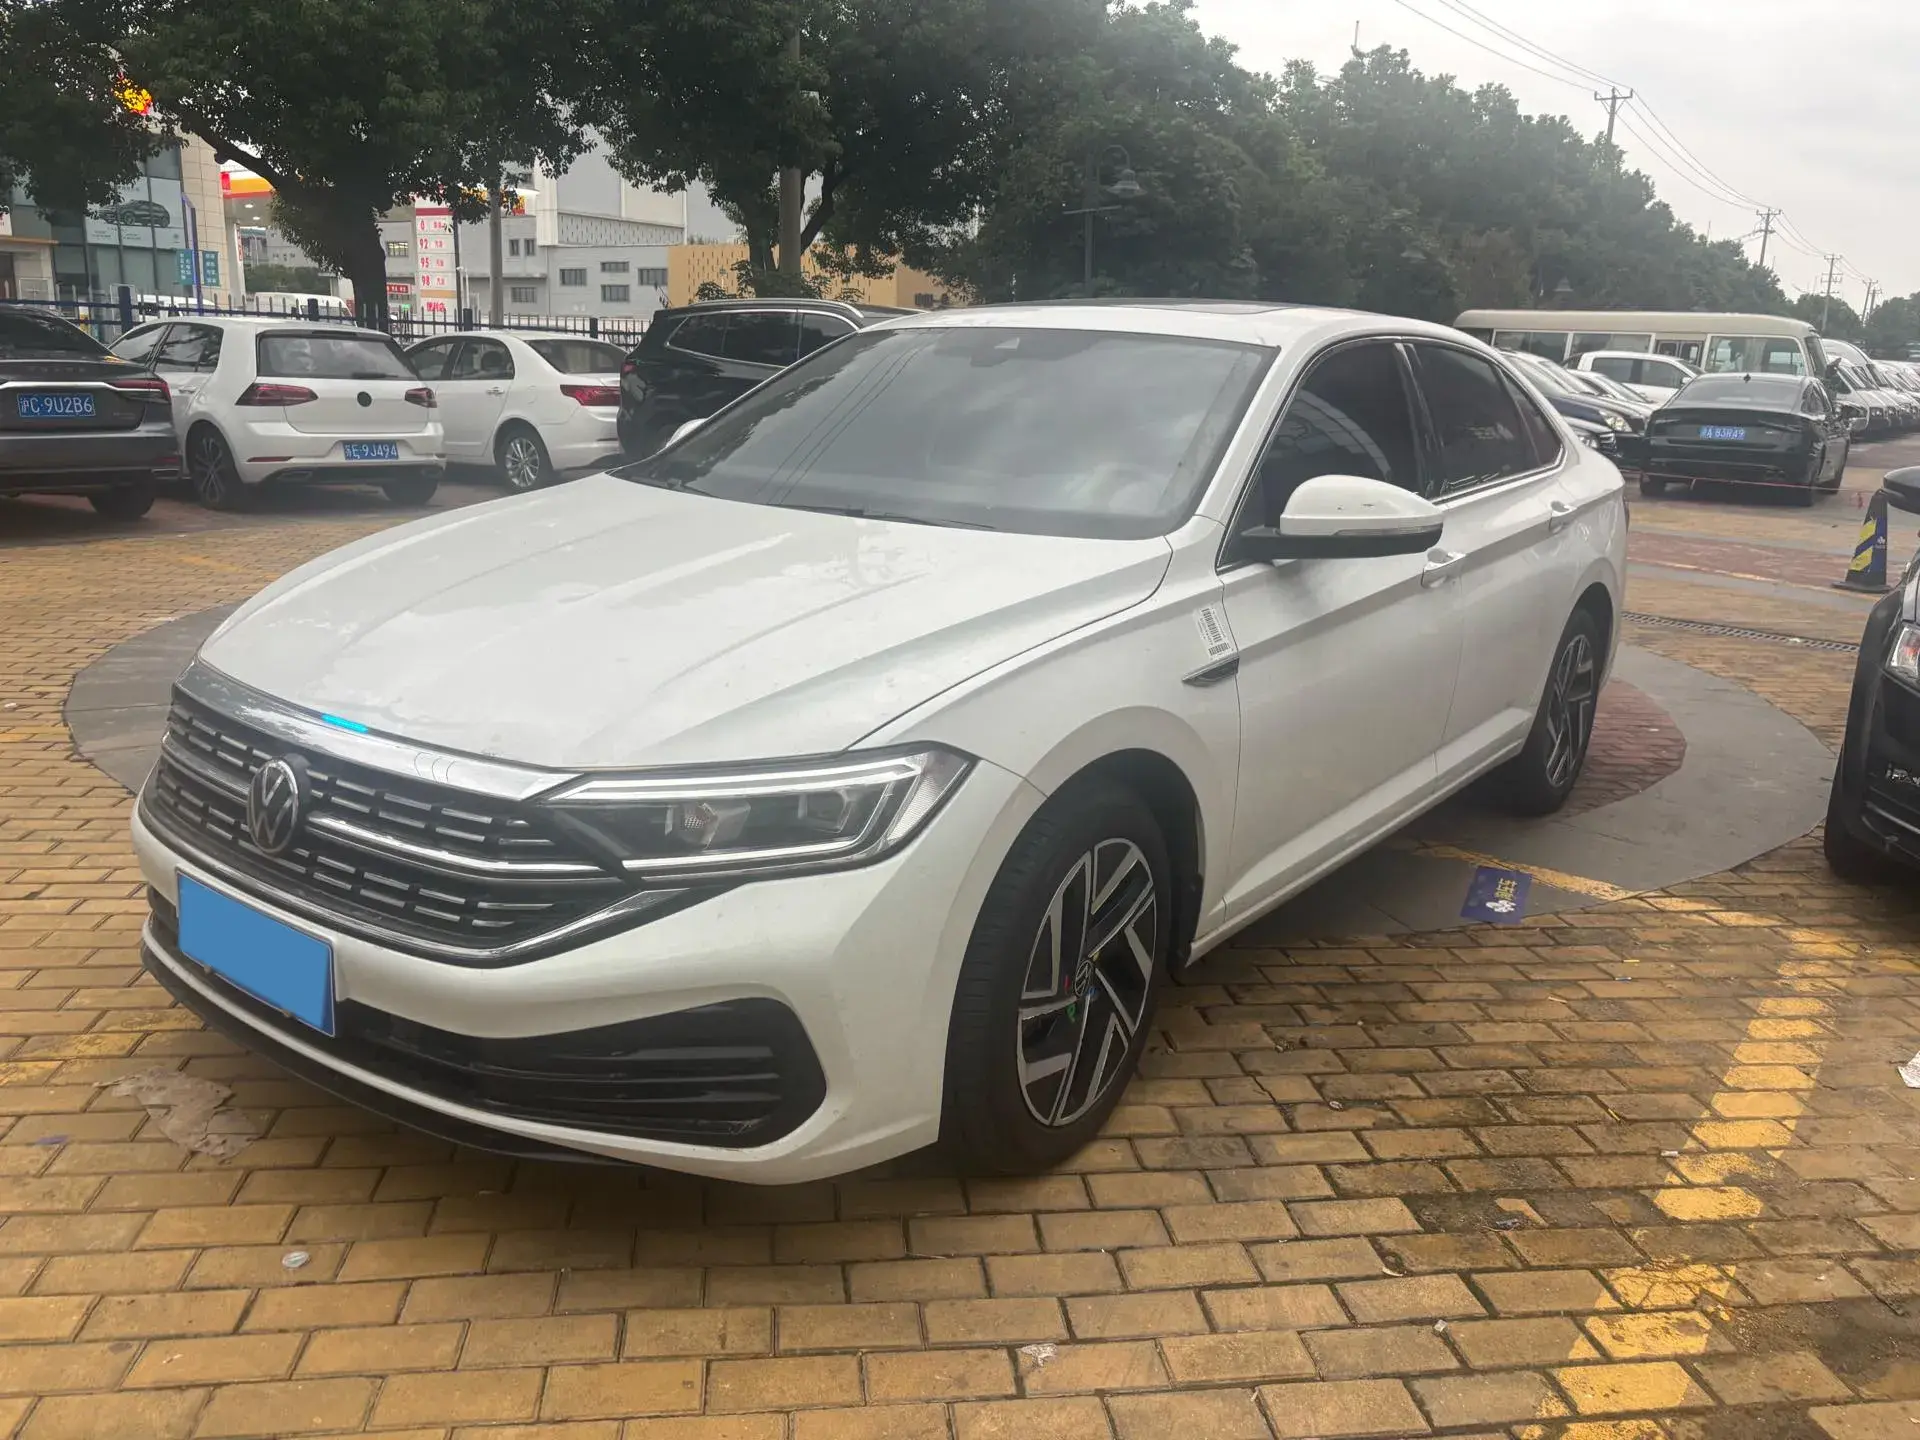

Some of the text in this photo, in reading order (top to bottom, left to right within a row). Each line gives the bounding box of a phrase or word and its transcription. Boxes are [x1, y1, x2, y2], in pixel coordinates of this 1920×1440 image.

[419, 238, 428, 249] 92
[420, 258, 429, 268] 95
[421, 275, 430, 285] 98
